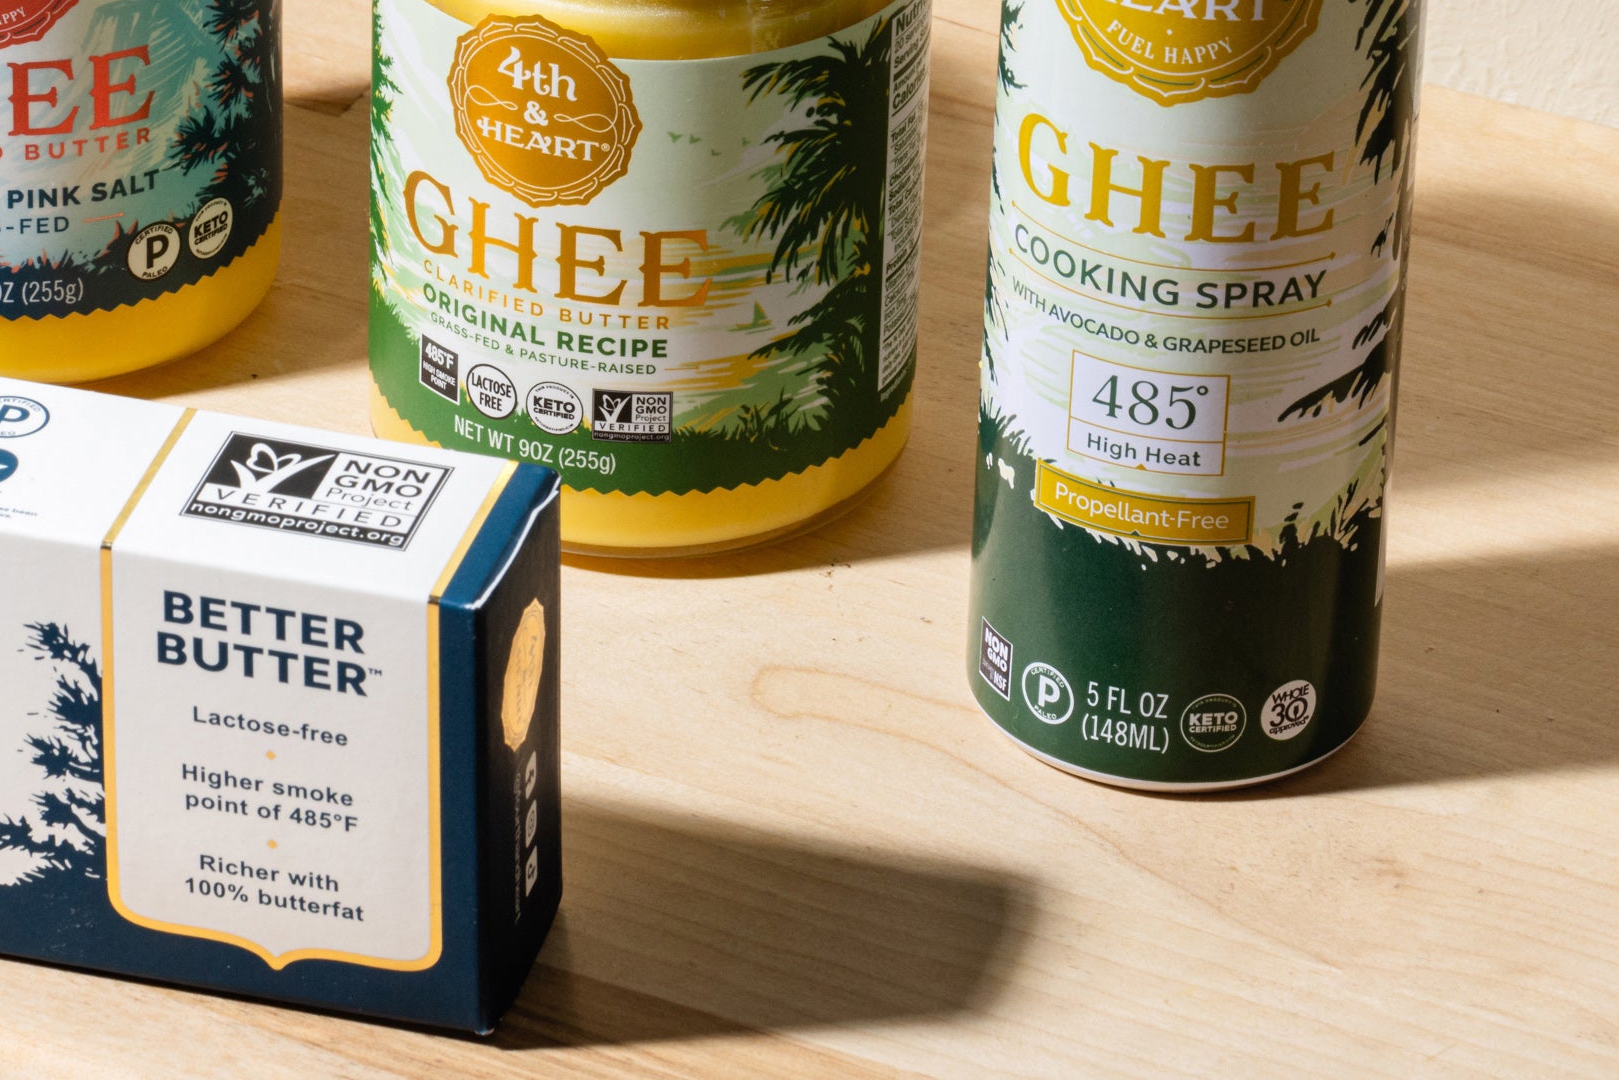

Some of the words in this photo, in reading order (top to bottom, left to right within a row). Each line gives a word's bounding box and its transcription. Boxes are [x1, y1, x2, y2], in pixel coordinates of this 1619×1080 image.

[1106, 19, 1155, 61] FUEL
[1164, 37, 1233, 64] HAPPY
[498, 46, 577, 102] 4th
[25, 127, 151, 161] BUTTER
[7, 186, 80, 209] PINK
[91, 169, 159, 202] SALT
[1018, 113, 1336, 243] GHEE
[402, 170, 712, 308] GHEE
[1015, 226, 1179, 306] COOKING
[1195, 270, 1327, 309] SPRAY
[22, 278, 84, 306] (255g)
[424, 259, 544, 317] CLARIFIED
[559, 308, 669, 330] BUTTER
[423, 282, 545, 346] ORIGINAL
[557, 331, 668, 358] RECIPE
[1012, 275, 1045, 312] WITH
[1049, 304, 1139, 346] AVOCADO
[1162, 335, 1286, 355] GRAPESEED
[1290, 328, 1321, 346] OIL
[430, 311, 499, 350] GRASS-FED
[520, 349, 656, 375] PASTURE-RAISED
[471, 372, 511, 398] LACTOSE
[479, 392, 502, 412] FREE
[533, 396, 575, 412] KETO
[636, 397, 666, 405] NON
[599, 423, 666, 432] VERIFIED
[635, 405, 666, 414] GMO
[635, 414, 666, 423] Project
[454, 414, 484, 443] NET
[488, 428, 515, 452] WT
[558, 447, 616, 475] (255g)
[1087, 433, 1137, 460] High
[1146, 446, 1201, 466] Heat
[333, 474, 425, 499] GMO
[342, 458, 431, 484] NON
[216, 487, 403, 528] VERIFIED
[325, 486, 414, 513] Project
[1055, 482, 1228, 530] Propellant-Free
[189, 500, 404, 547] nongmoproject.org
[163, 590, 365, 654] BETTER
[985, 627, 1008, 660] NON
[987, 648, 1007, 672] GMO
[1087, 681, 1099, 707] 5
[1108, 685, 1131, 714] FL
[1140, 692, 1169, 719] OZ
[1272, 684, 1310, 704] WHOLE
[192, 705, 349, 747] Lactose-free
[1082, 713, 1169, 754] (148ML)
[1189, 711, 1238, 726] KETO
[1189, 724, 1237, 733] CERTIFIED
[182, 763, 264, 795] Higher
[272, 781, 354, 806] smoke
[185, 792, 249, 820] point
[257, 803, 283, 821] of
[199, 853, 280, 883] Richer
[288, 870, 339, 893] with
[184, 877, 249, 903] 100%
[258, 887, 365, 923] butterfat
